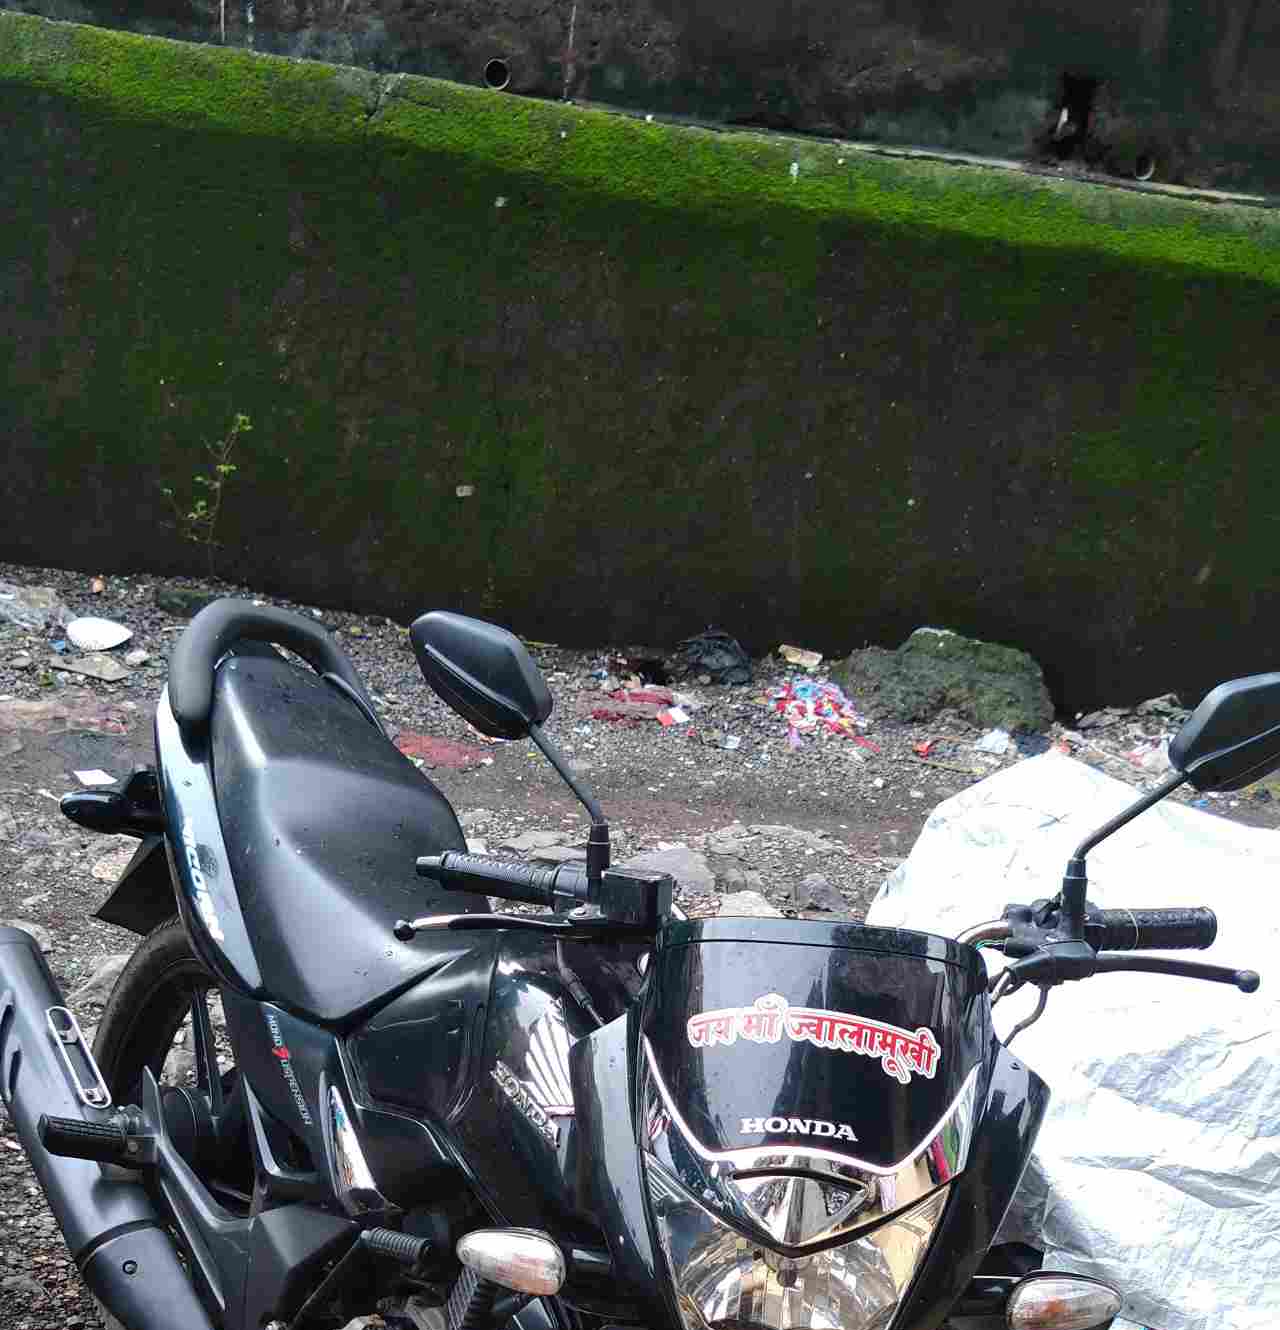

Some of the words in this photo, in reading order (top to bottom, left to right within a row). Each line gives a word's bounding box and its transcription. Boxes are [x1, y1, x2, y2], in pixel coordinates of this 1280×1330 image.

[689, 1010, 736, 1047] जय
[490, 1060, 559, 1148] HONDA
[739, 1117, 858, 1142] HONDA
